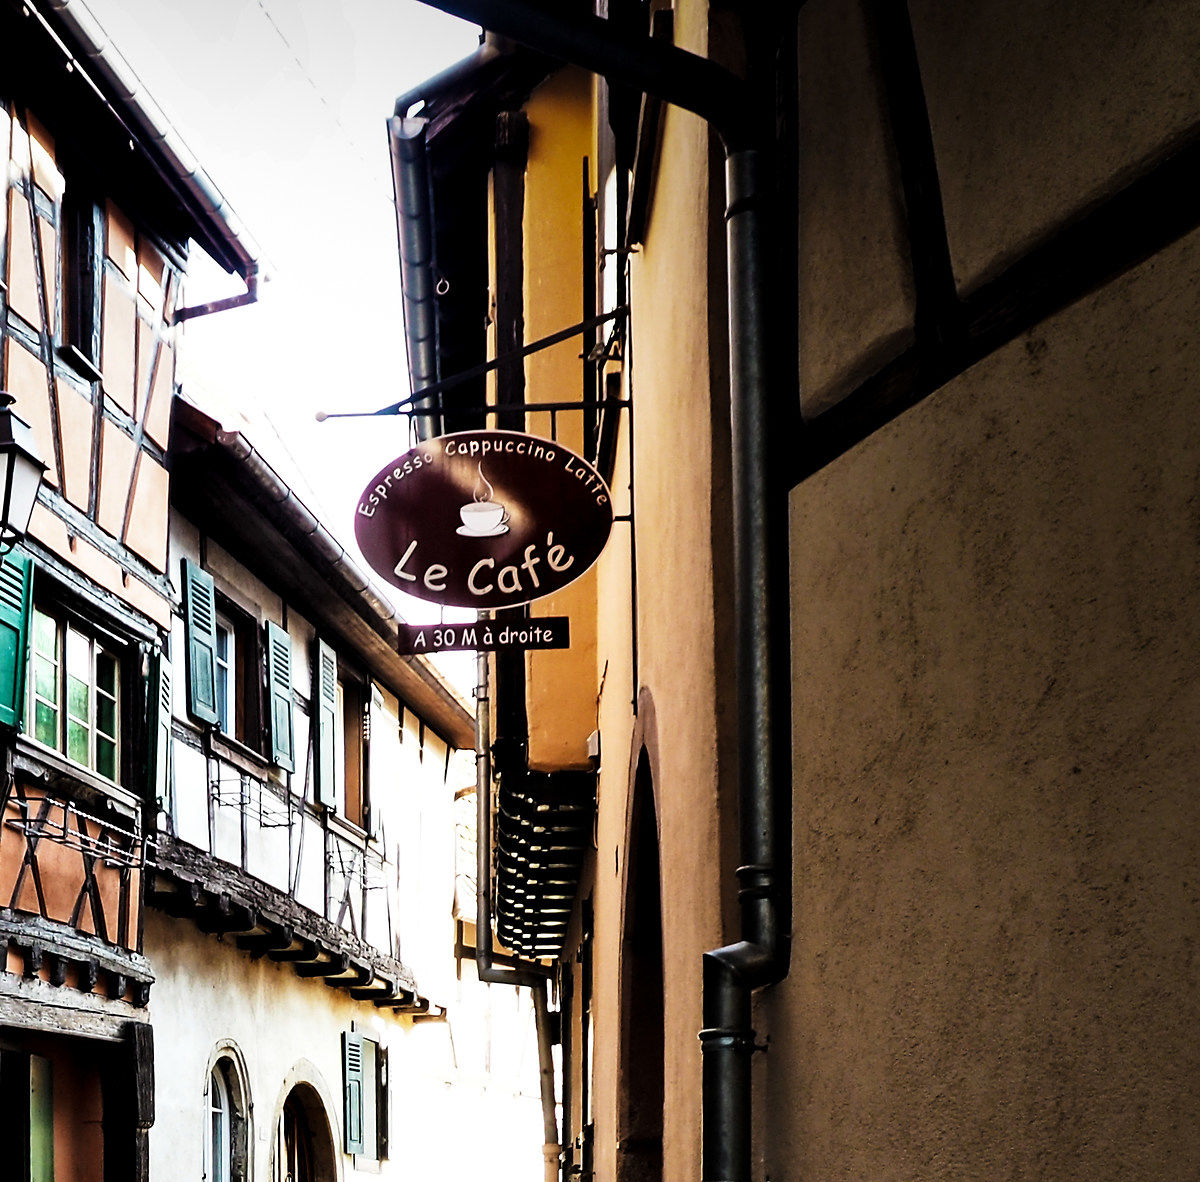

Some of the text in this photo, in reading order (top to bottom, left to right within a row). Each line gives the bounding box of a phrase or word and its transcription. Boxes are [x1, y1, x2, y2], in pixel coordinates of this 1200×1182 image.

[358, 439, 608, 519] Espresso Cappuccino Latte
[393, 531, 575, 597] Le Café
[413, 626, 553, 648] A 30 M à droite
